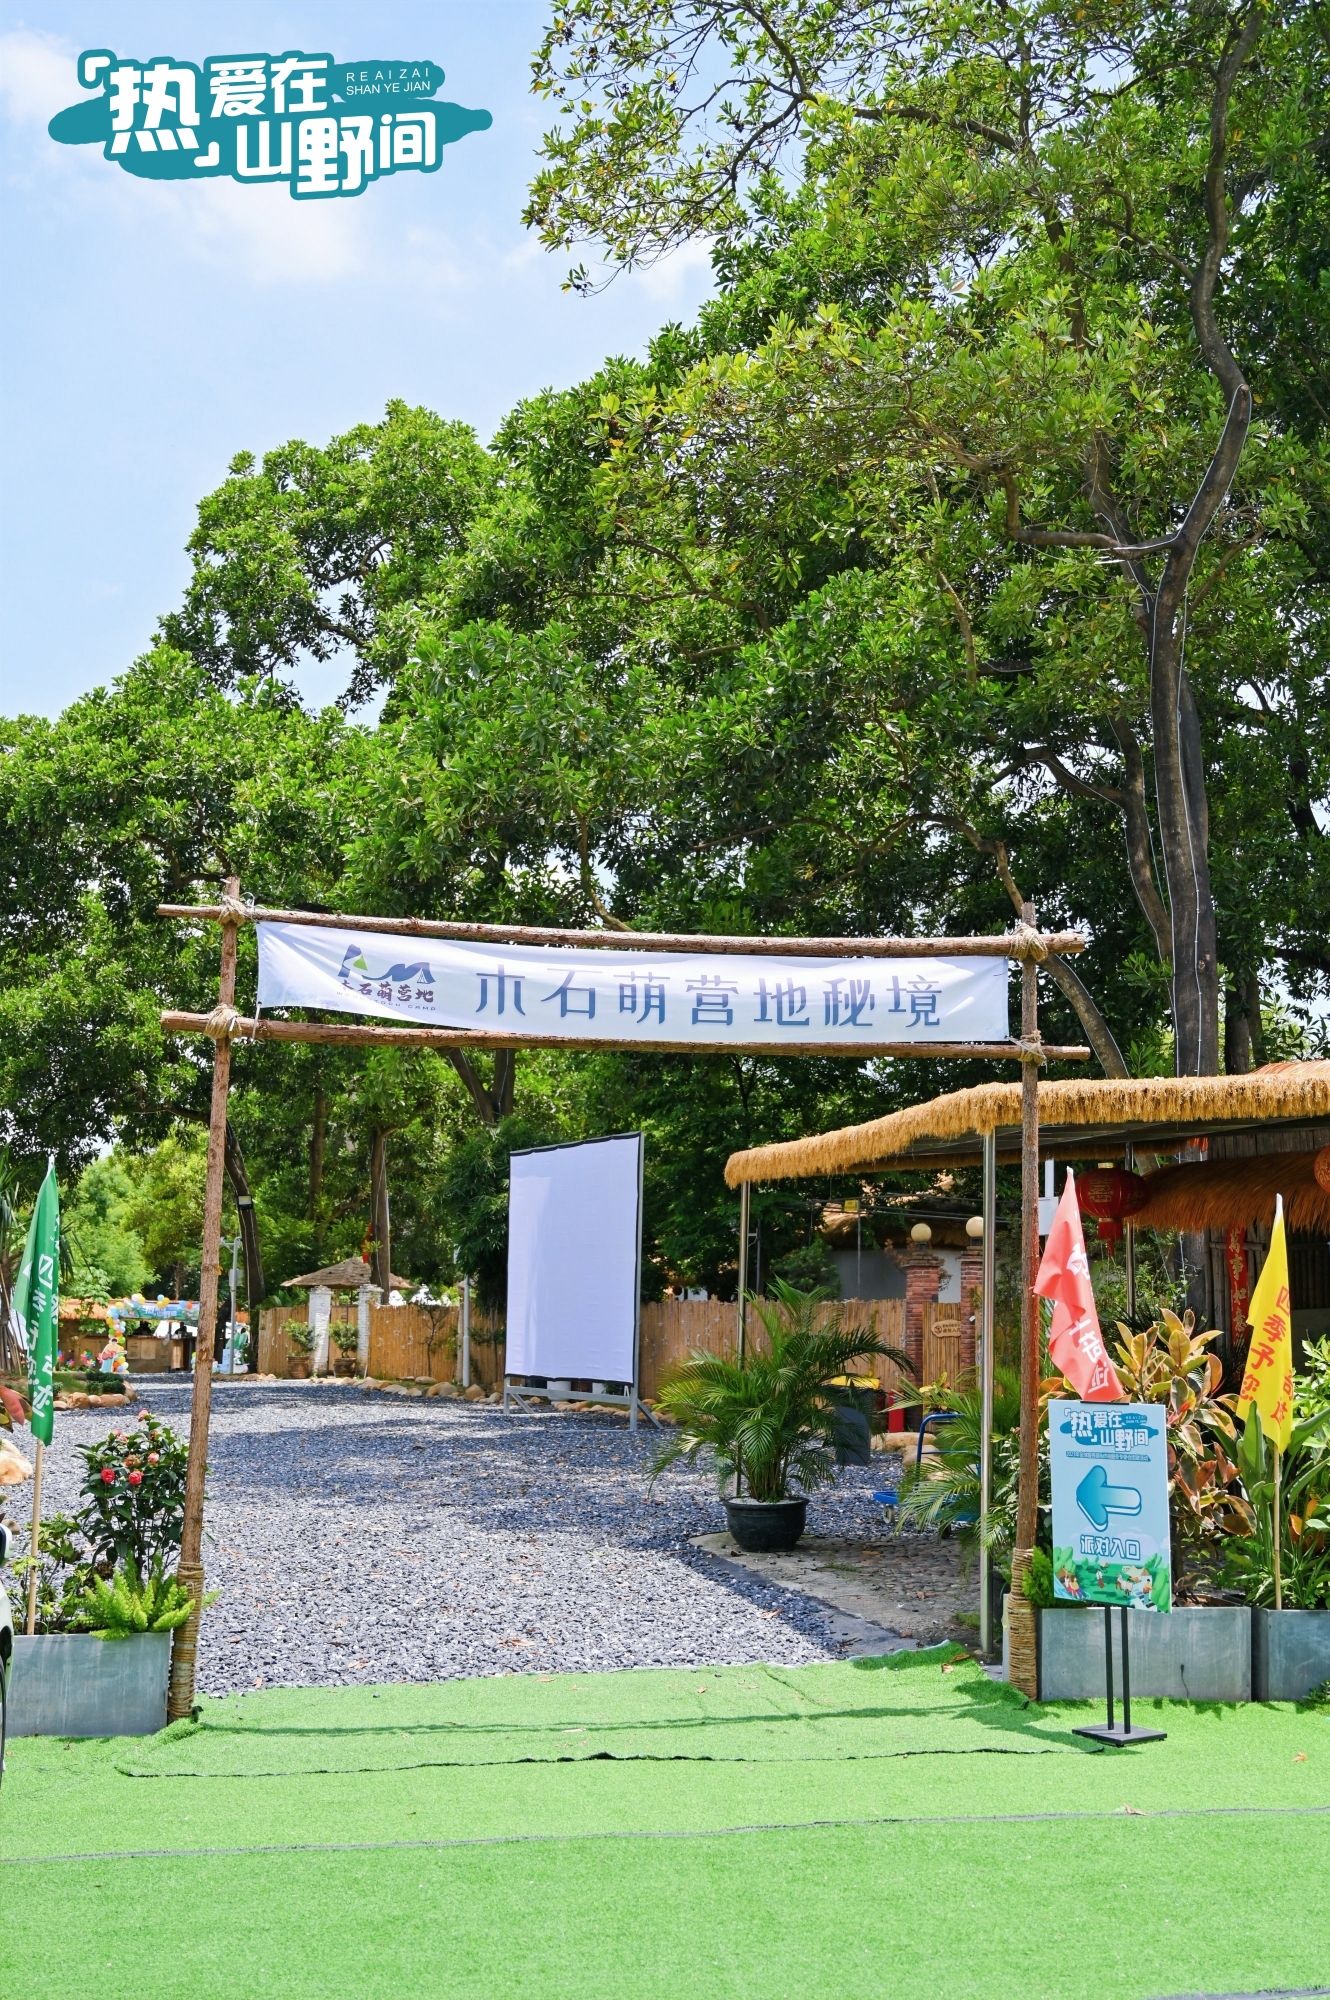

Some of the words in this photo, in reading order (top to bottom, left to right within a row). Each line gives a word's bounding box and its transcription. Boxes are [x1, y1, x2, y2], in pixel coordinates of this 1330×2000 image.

[475, 963, 942, 1029] 木石萌营地秘境
[1100, 1428, 1149, 1452] 山野间
[1080, 1534, 1141, 1560] 派对入口
